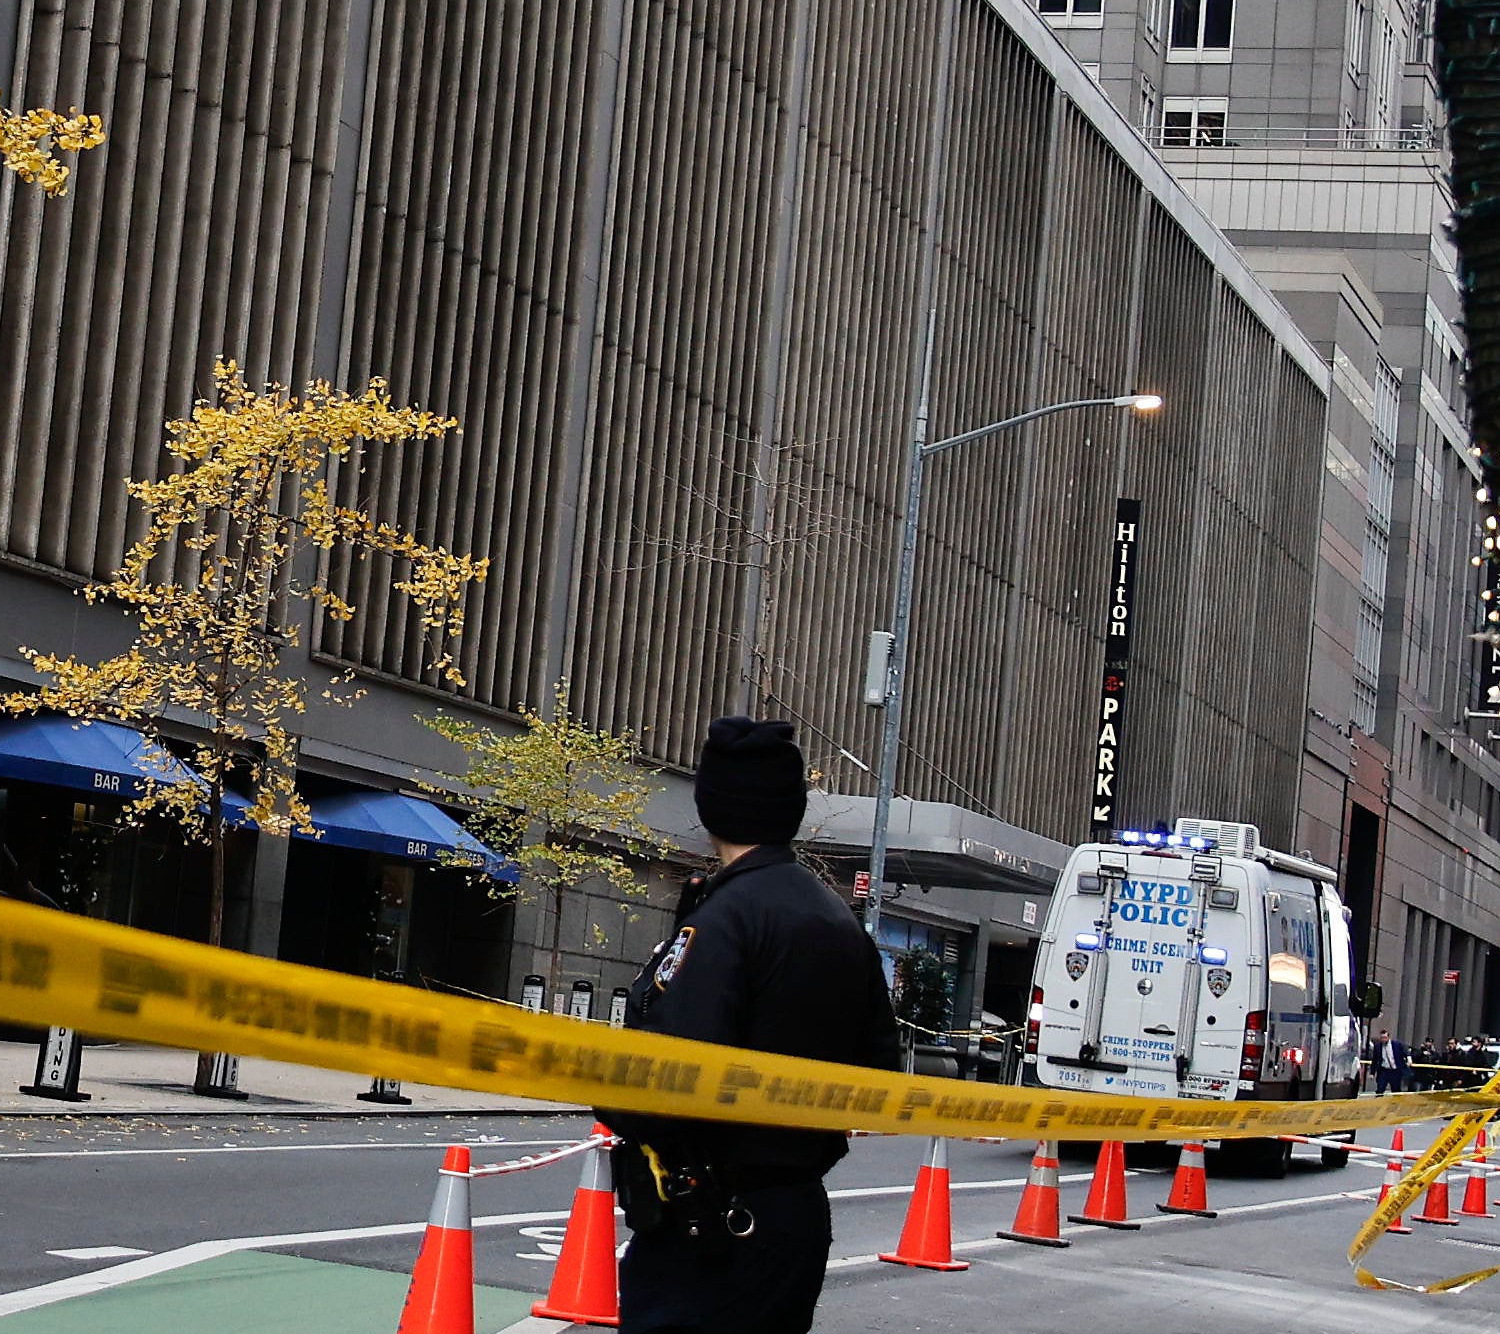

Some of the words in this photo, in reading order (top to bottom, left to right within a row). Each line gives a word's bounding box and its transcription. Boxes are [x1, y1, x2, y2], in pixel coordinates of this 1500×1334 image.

[1112, 523, 1135, 636] Hilton
[1098, 698, 1118, 797] PARK
[94, 773, 120, 791] BAR
[407, 842, 428, 857] BAR
[1119, 879, 1194, 905] NYPD
[1106, 937, 1147, 953] CRIME
[1131, 958, 1164, 974] UNIT
[1102, 1035, 1130, 1046] CRIME
[1132, 1038, 1175, 1052] STOPPERS
[50, 1027, 67, 1081] DING
[1104, 1046, 1171, 1062] 1-800-577-TIPS
